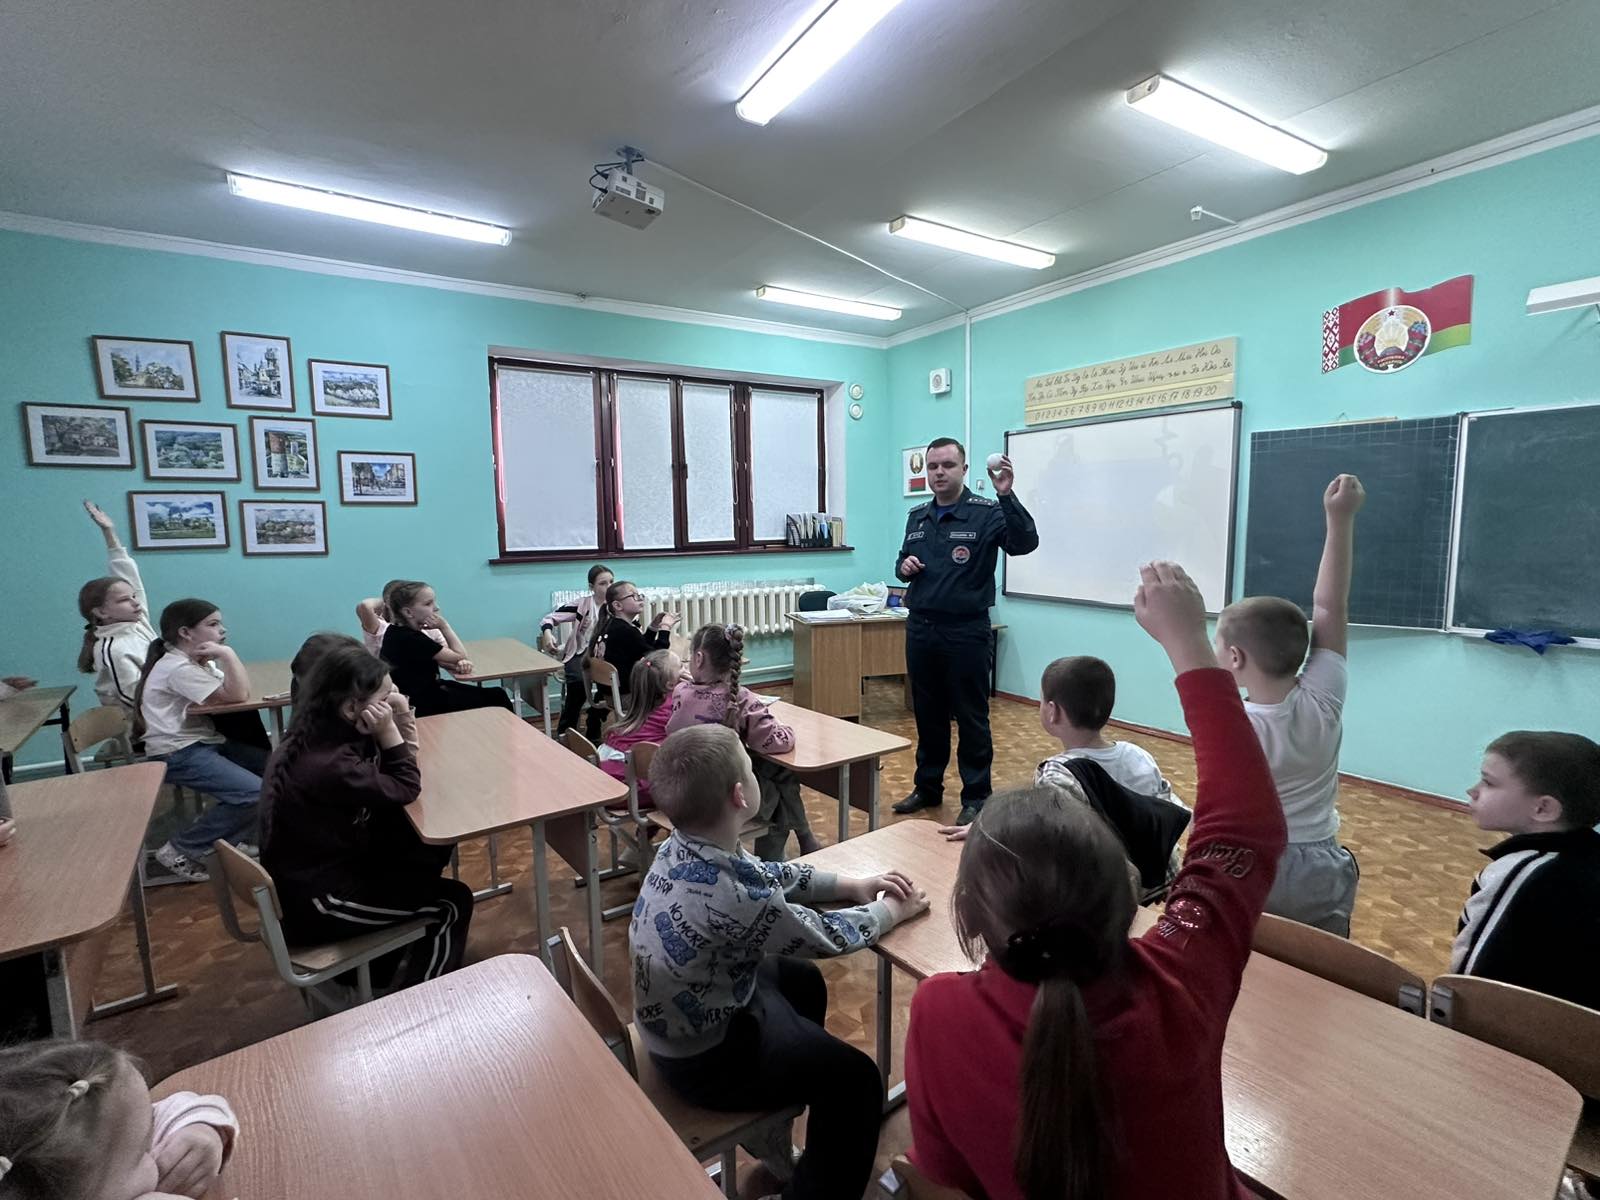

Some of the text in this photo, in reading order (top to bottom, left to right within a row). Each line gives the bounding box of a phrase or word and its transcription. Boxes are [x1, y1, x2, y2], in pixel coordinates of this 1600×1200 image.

[799, 869, 812, 891] STOP
[765, 904, 781, 924] NO
[669, 902, 683, 921] NO
[676, 920, 713, 950] MORE
